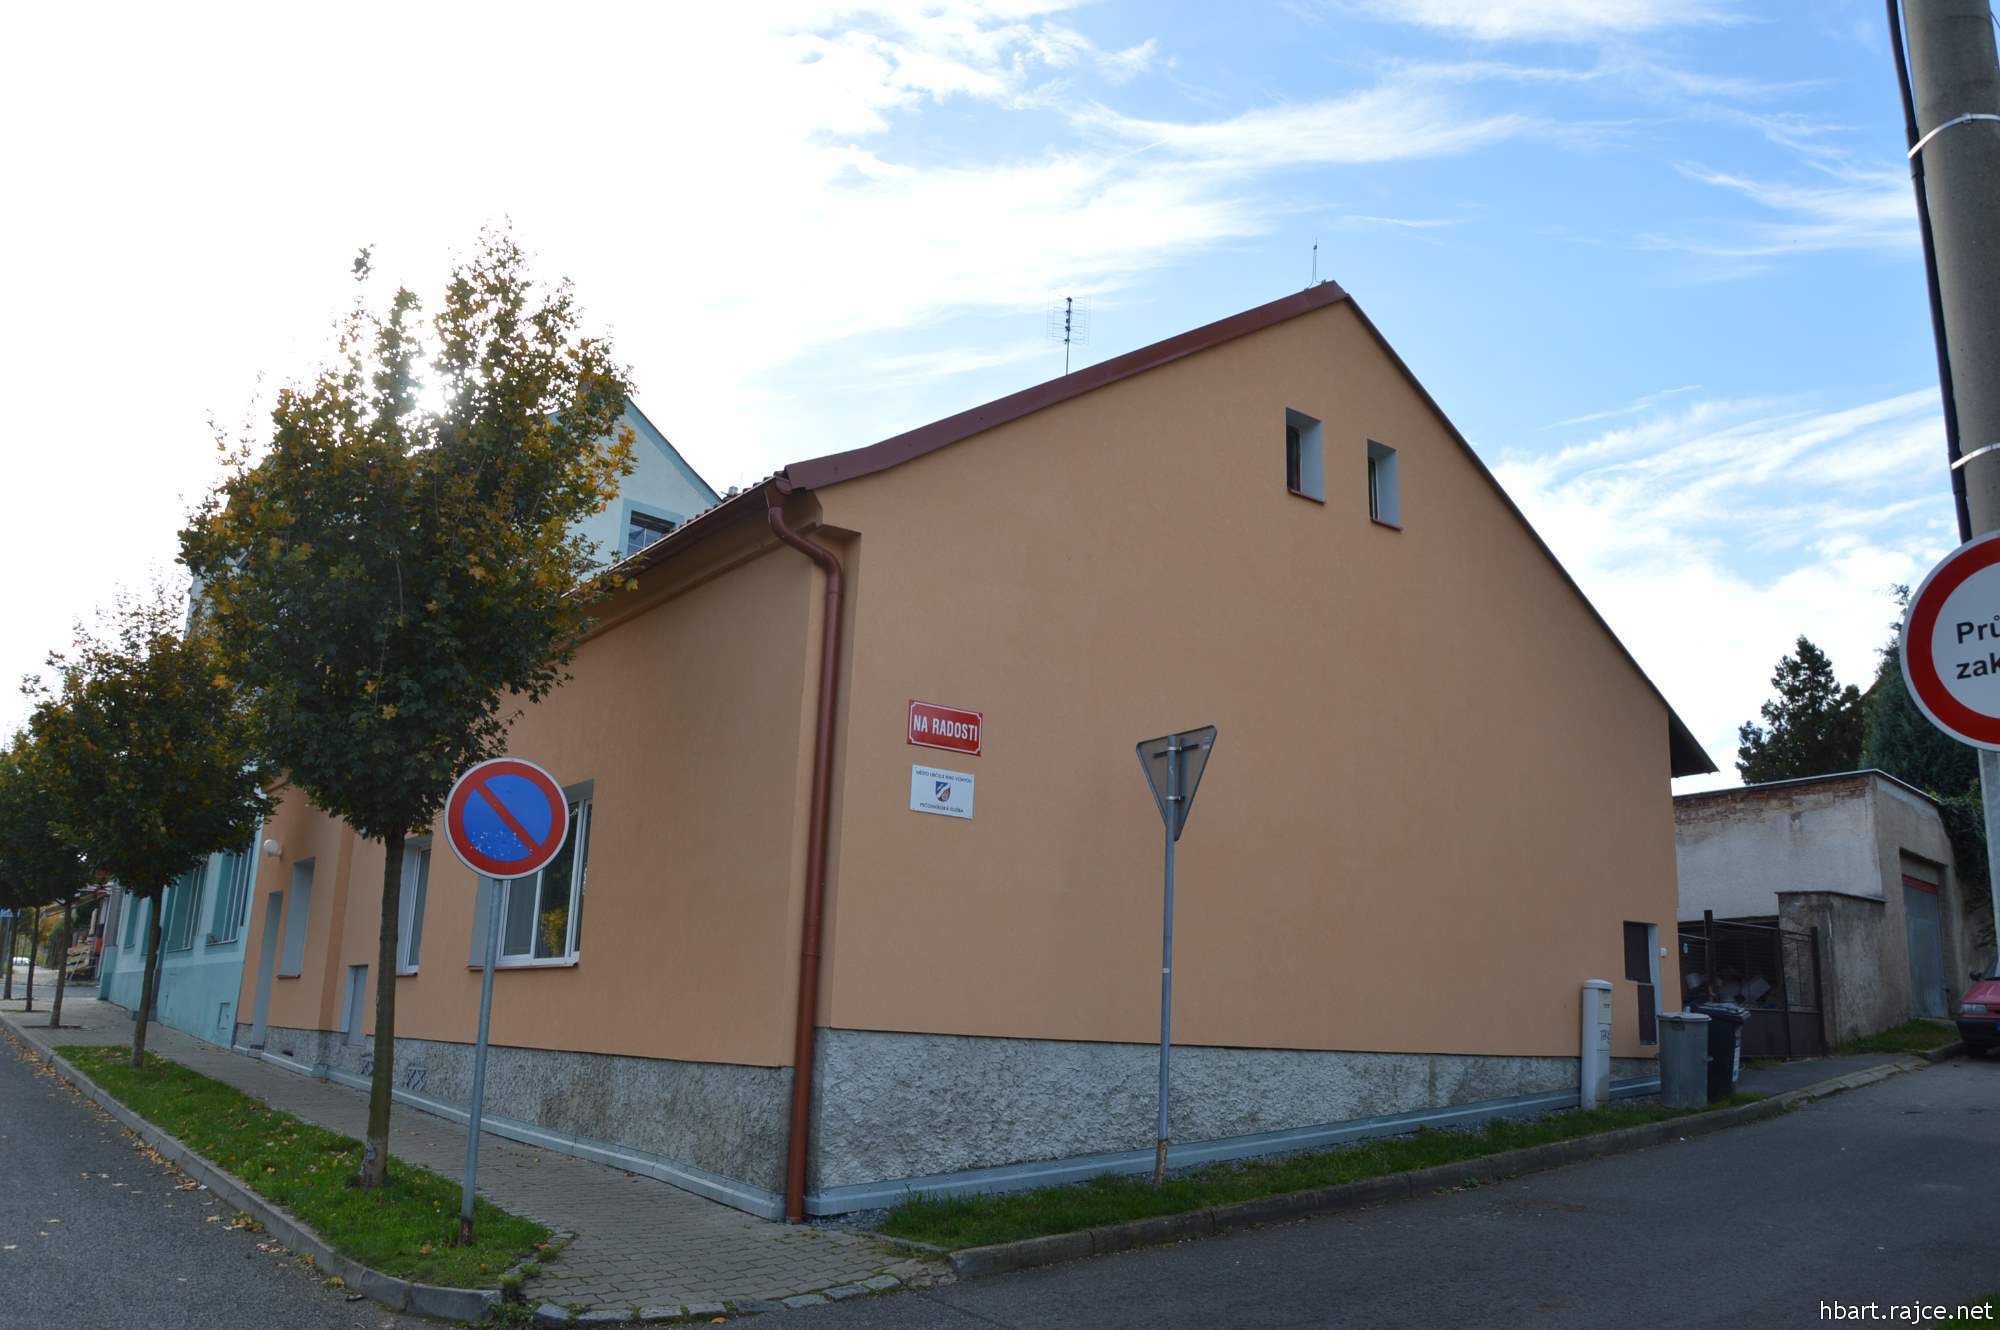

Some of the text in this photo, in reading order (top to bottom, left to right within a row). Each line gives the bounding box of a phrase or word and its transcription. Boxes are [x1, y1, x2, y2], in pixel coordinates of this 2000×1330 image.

[1956, 615, 2000, 644] Prů
[1956, 652, 2000, 680] zak
[913, 715, 977, 741] NA RADOSTI
